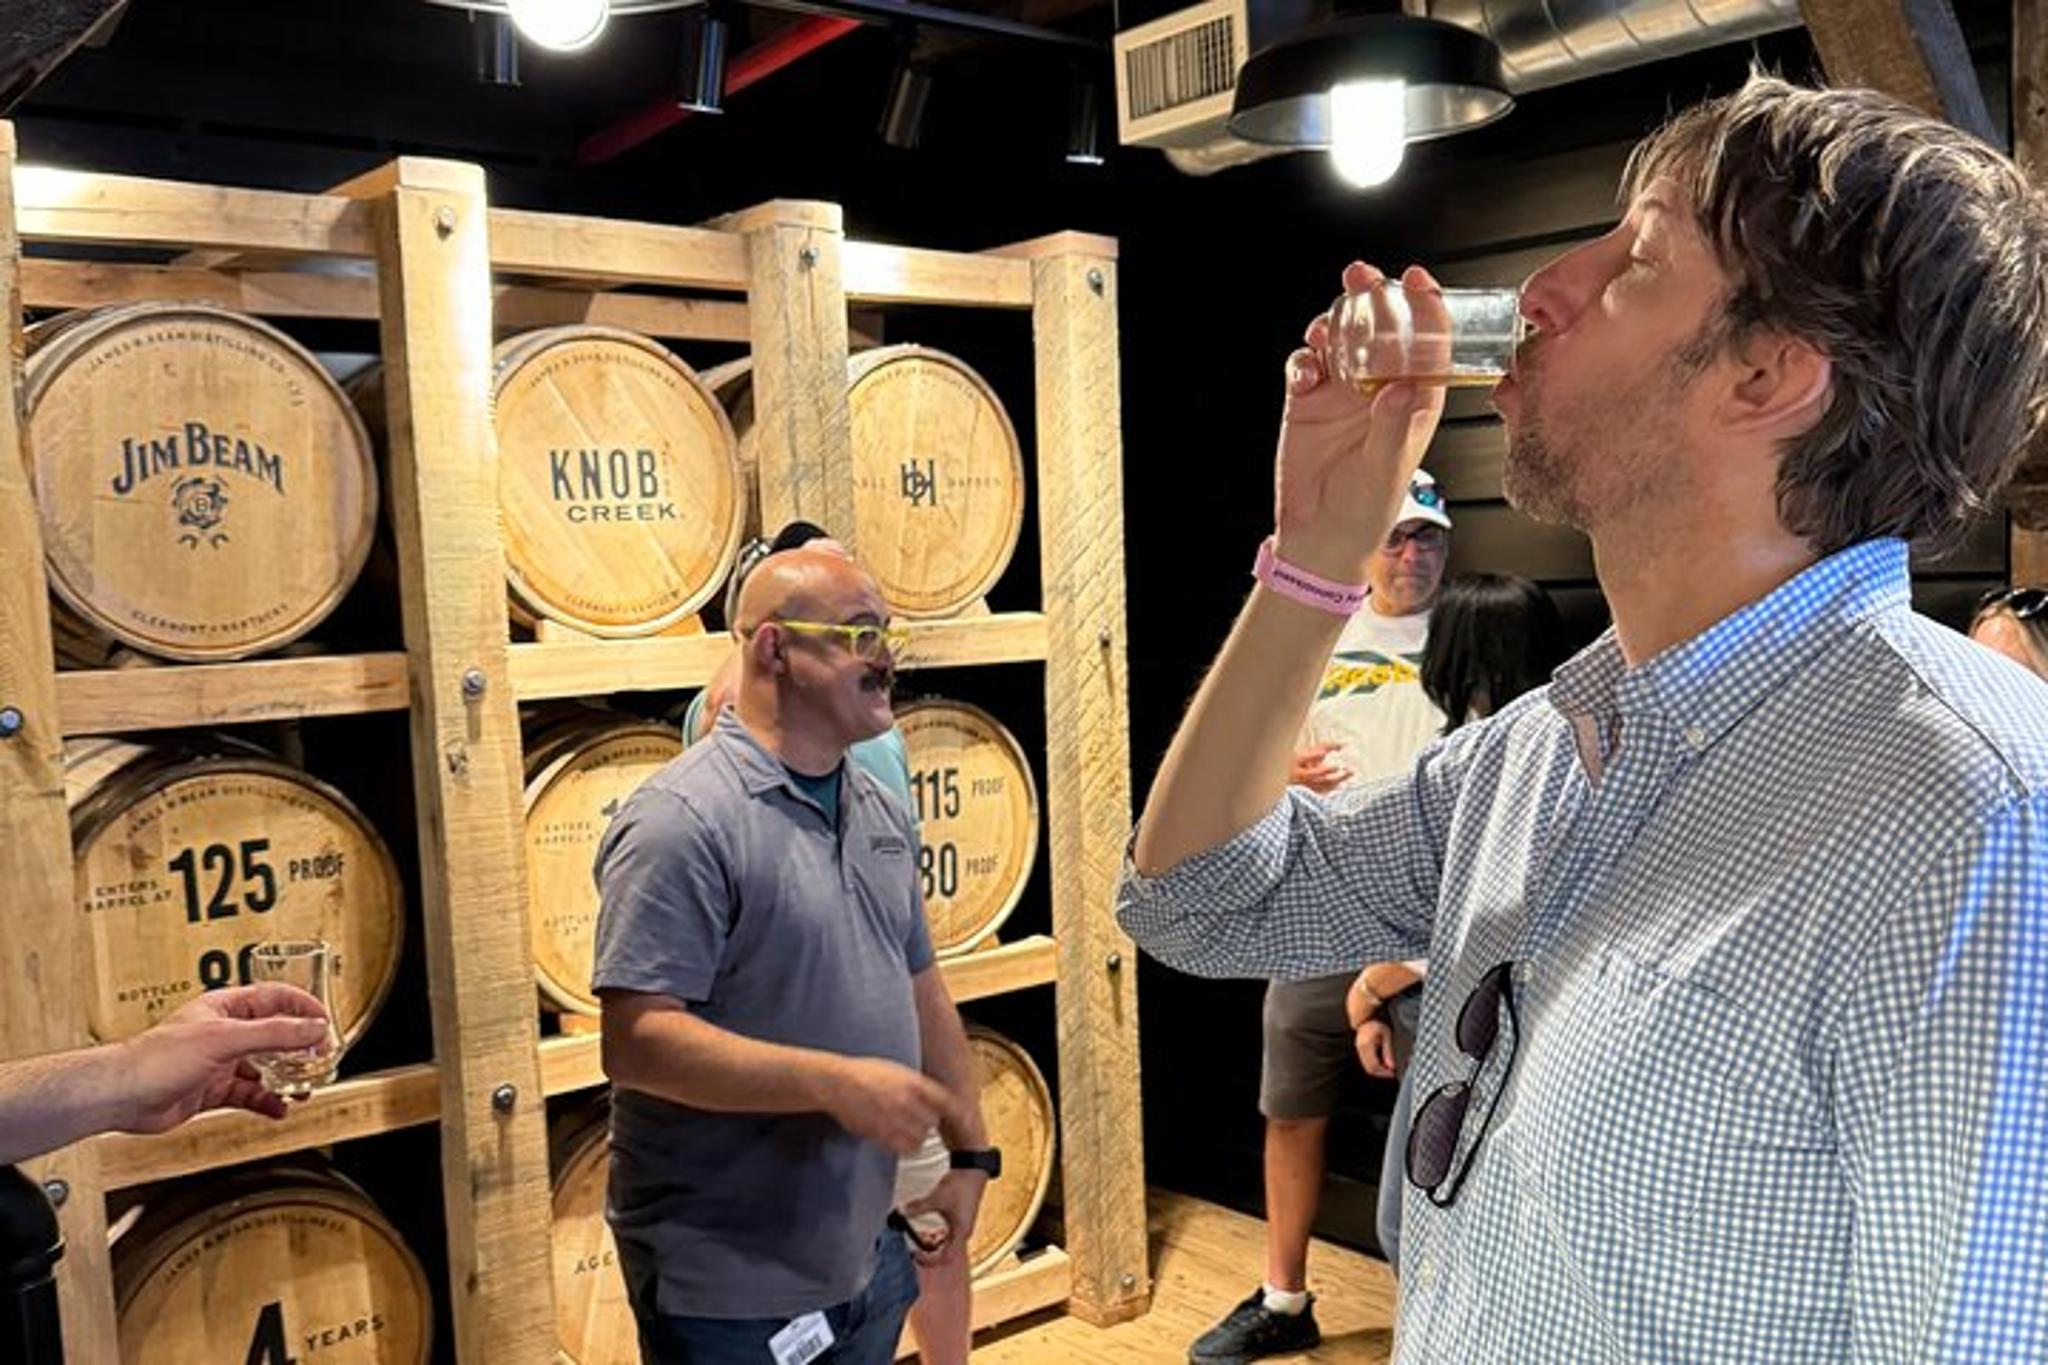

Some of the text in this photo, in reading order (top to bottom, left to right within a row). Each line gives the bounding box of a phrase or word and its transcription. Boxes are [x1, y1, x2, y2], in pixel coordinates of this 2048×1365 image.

[112, 422, 287, 497] JIM BEAM
[550, 449, 659, 501] KNOB
[567, 503, 676, 523] CREEK
[911, 769, 1006, 822] 115 PROOF
[965, 856, 999, 876] PROOF
[96, 880, 158, 897] ENTERS
[168, 838, 346, 924] 125 PROOF
[83, 889, 173, 913] BARREL AT
[542, 913, 594, 929] BOTTLE
[118, 980, 191, 1002] BOTTLED
[146, 997, 165, 1011] AT
[245, 1301, 385, 1365] 4 YEARS
